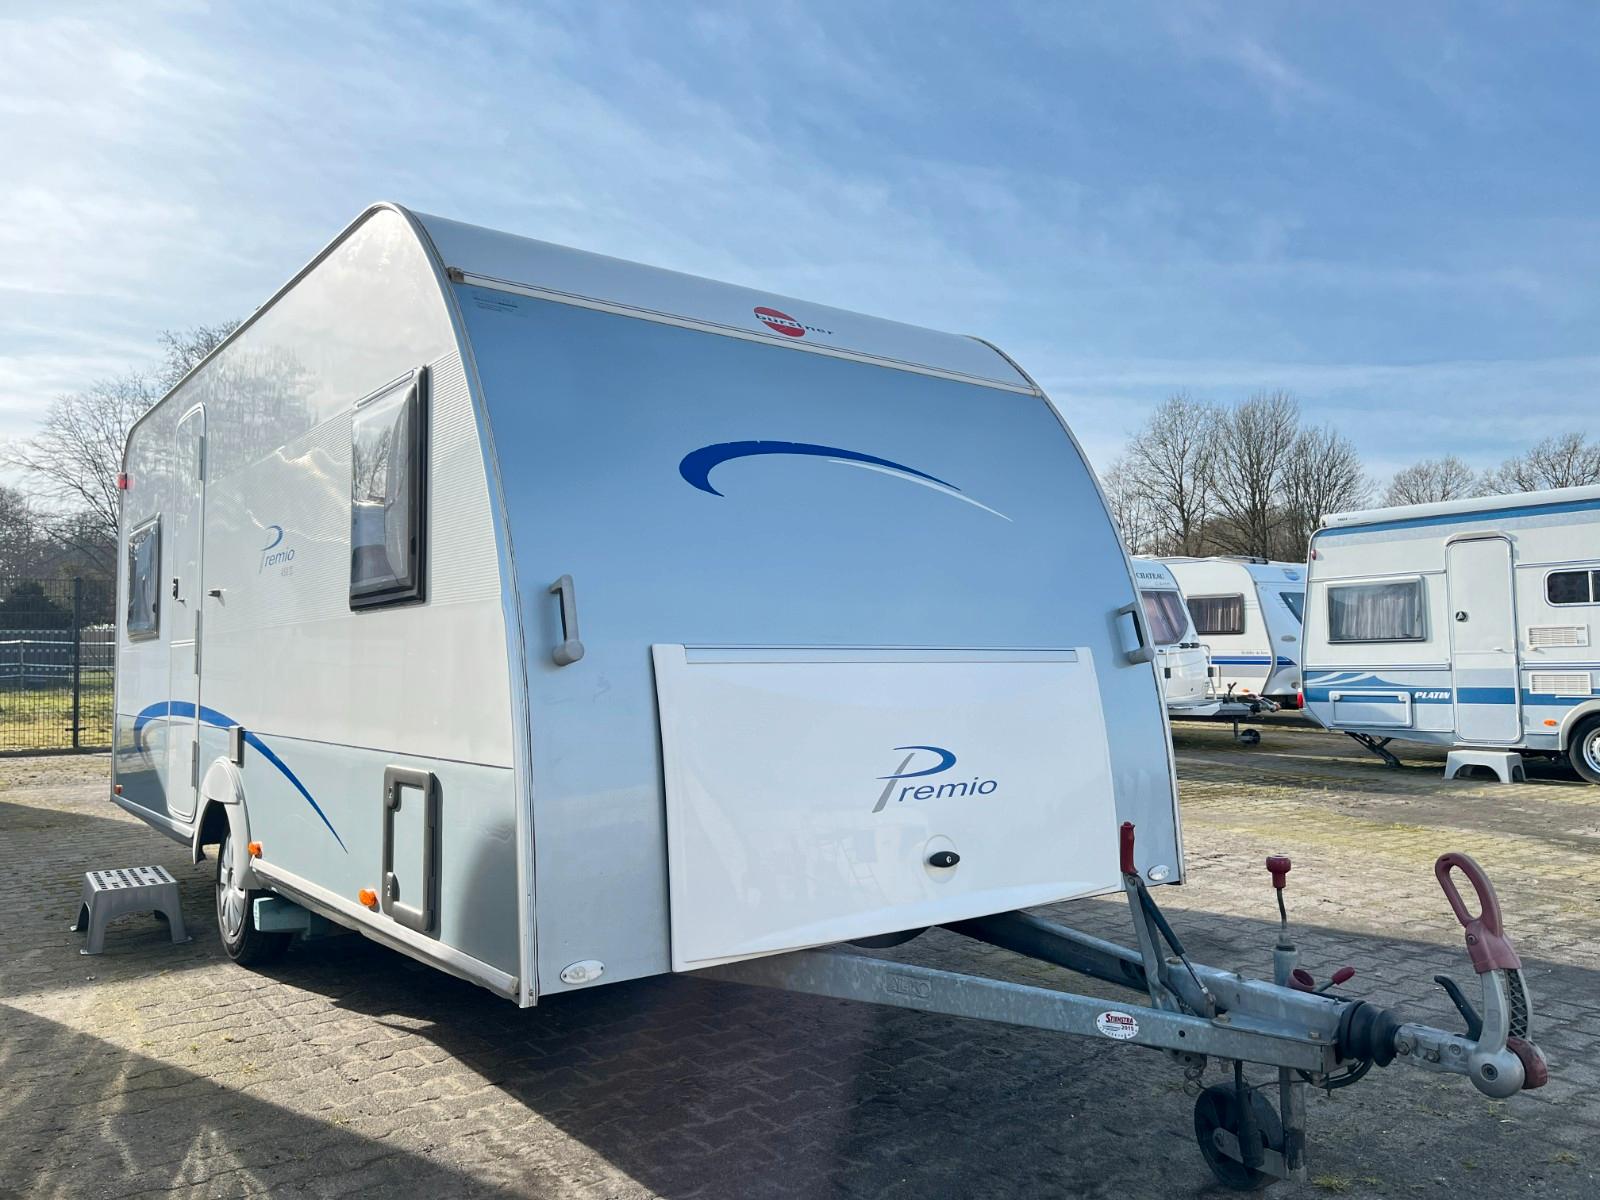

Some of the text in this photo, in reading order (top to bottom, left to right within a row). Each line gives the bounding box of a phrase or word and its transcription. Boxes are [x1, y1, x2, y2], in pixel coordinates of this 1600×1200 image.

[258, 525, 296, 575] Premio
[1414, 691, 1451, 699] PLATIN
[872, 746, 998, 813] Premio
